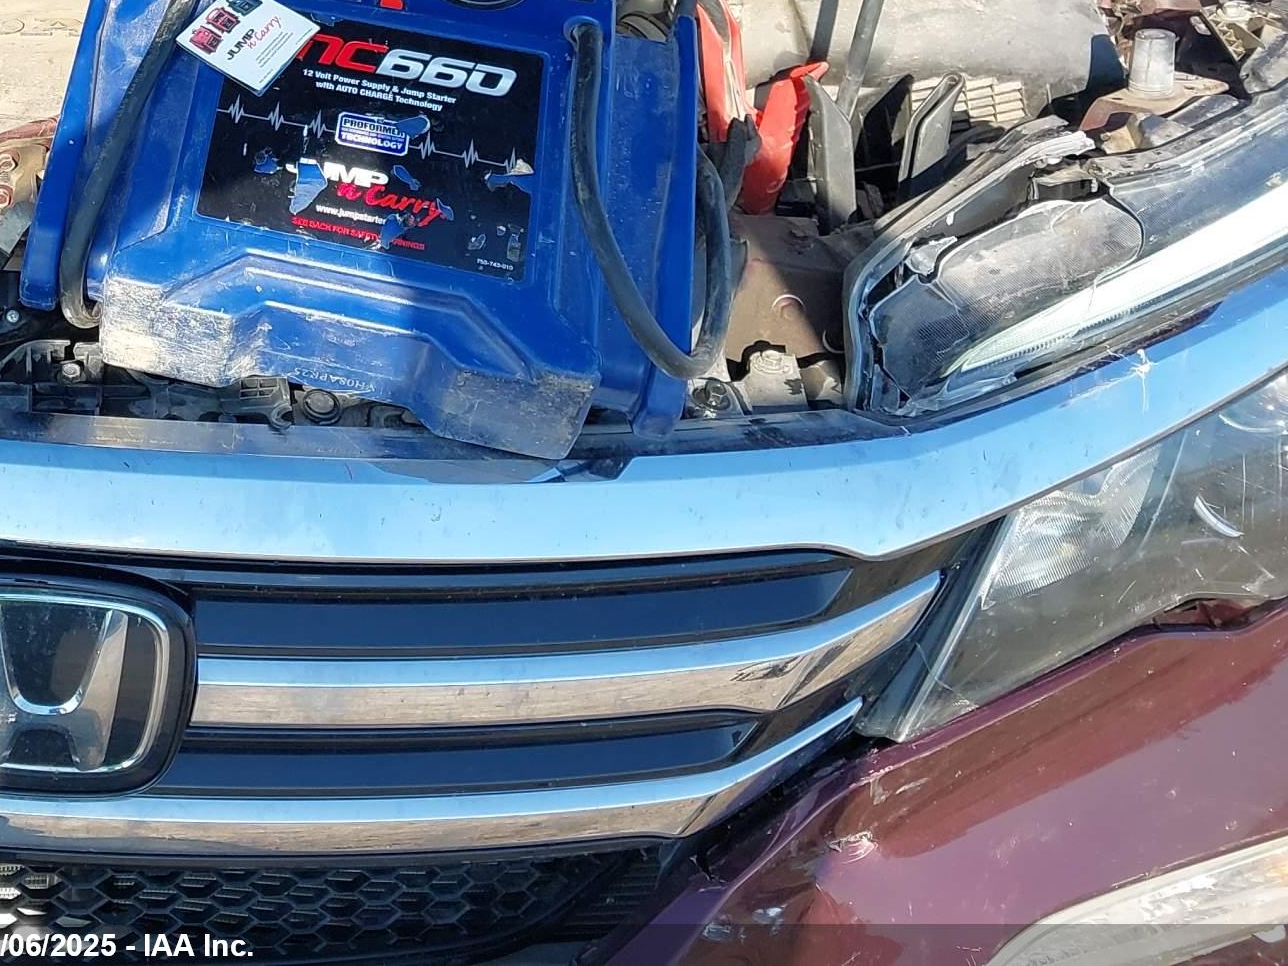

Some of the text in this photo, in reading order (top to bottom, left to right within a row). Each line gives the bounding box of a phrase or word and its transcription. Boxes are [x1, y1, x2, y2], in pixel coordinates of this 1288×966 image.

[255, 15, 282, 41] Carry
[227, 28, 255, 61] JUMP
[303, 68, 457, 104] 12 Volt Power Supply & Jump Starter
[315, 81, 443, 112] with AUTO CHARGE Technology
[341, 132, 404, 150] TECHNOLOGY
[365, 184, 441, 227] Carry
[332, 224, 350, 236] FOR
